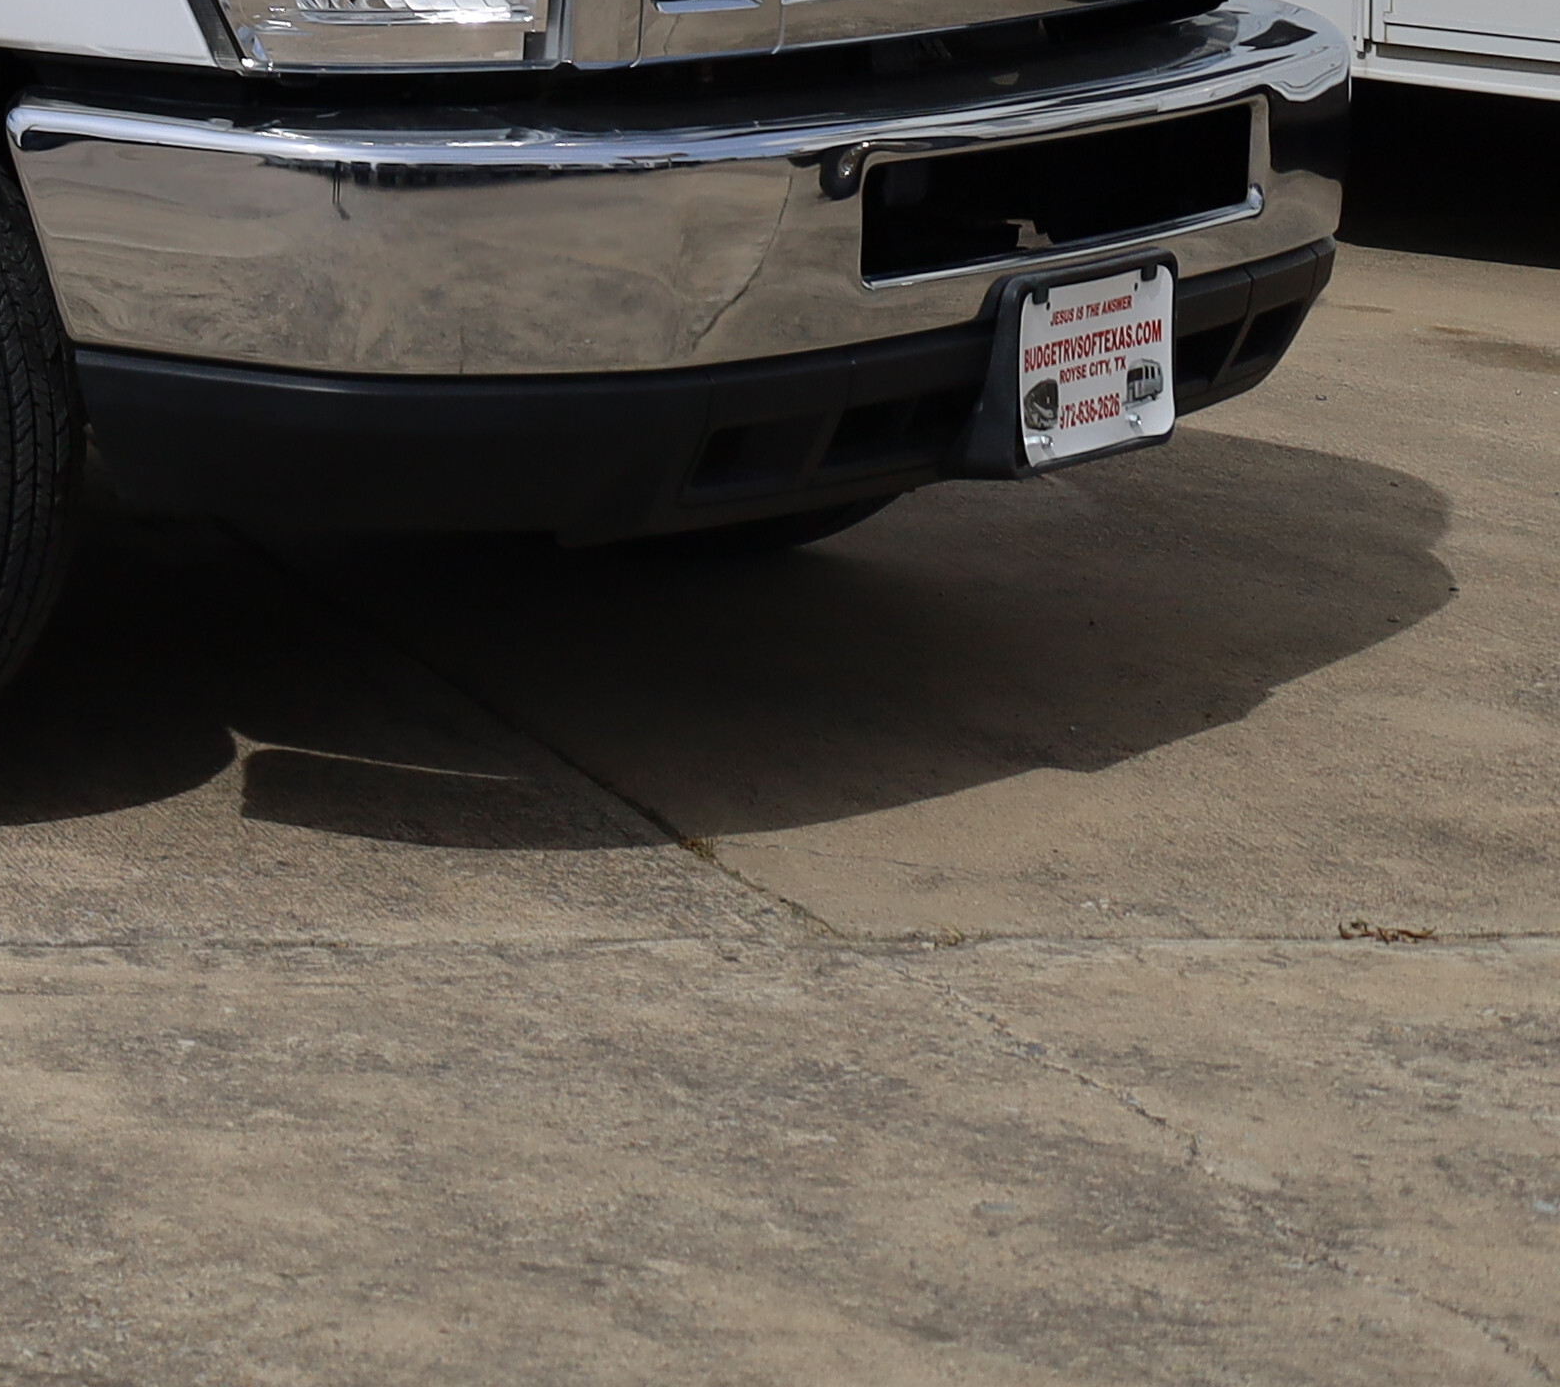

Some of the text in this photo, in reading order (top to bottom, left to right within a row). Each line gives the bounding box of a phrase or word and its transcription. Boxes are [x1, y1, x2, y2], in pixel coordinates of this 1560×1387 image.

[1050, 295, 1132, 326] JESUS IS THE ANSWER
[1024, 319, 1162, 373] BUDGETRVSOFTEXAS.COM
[1059, 355, 1127, 384] ROYSE CITY, TX
